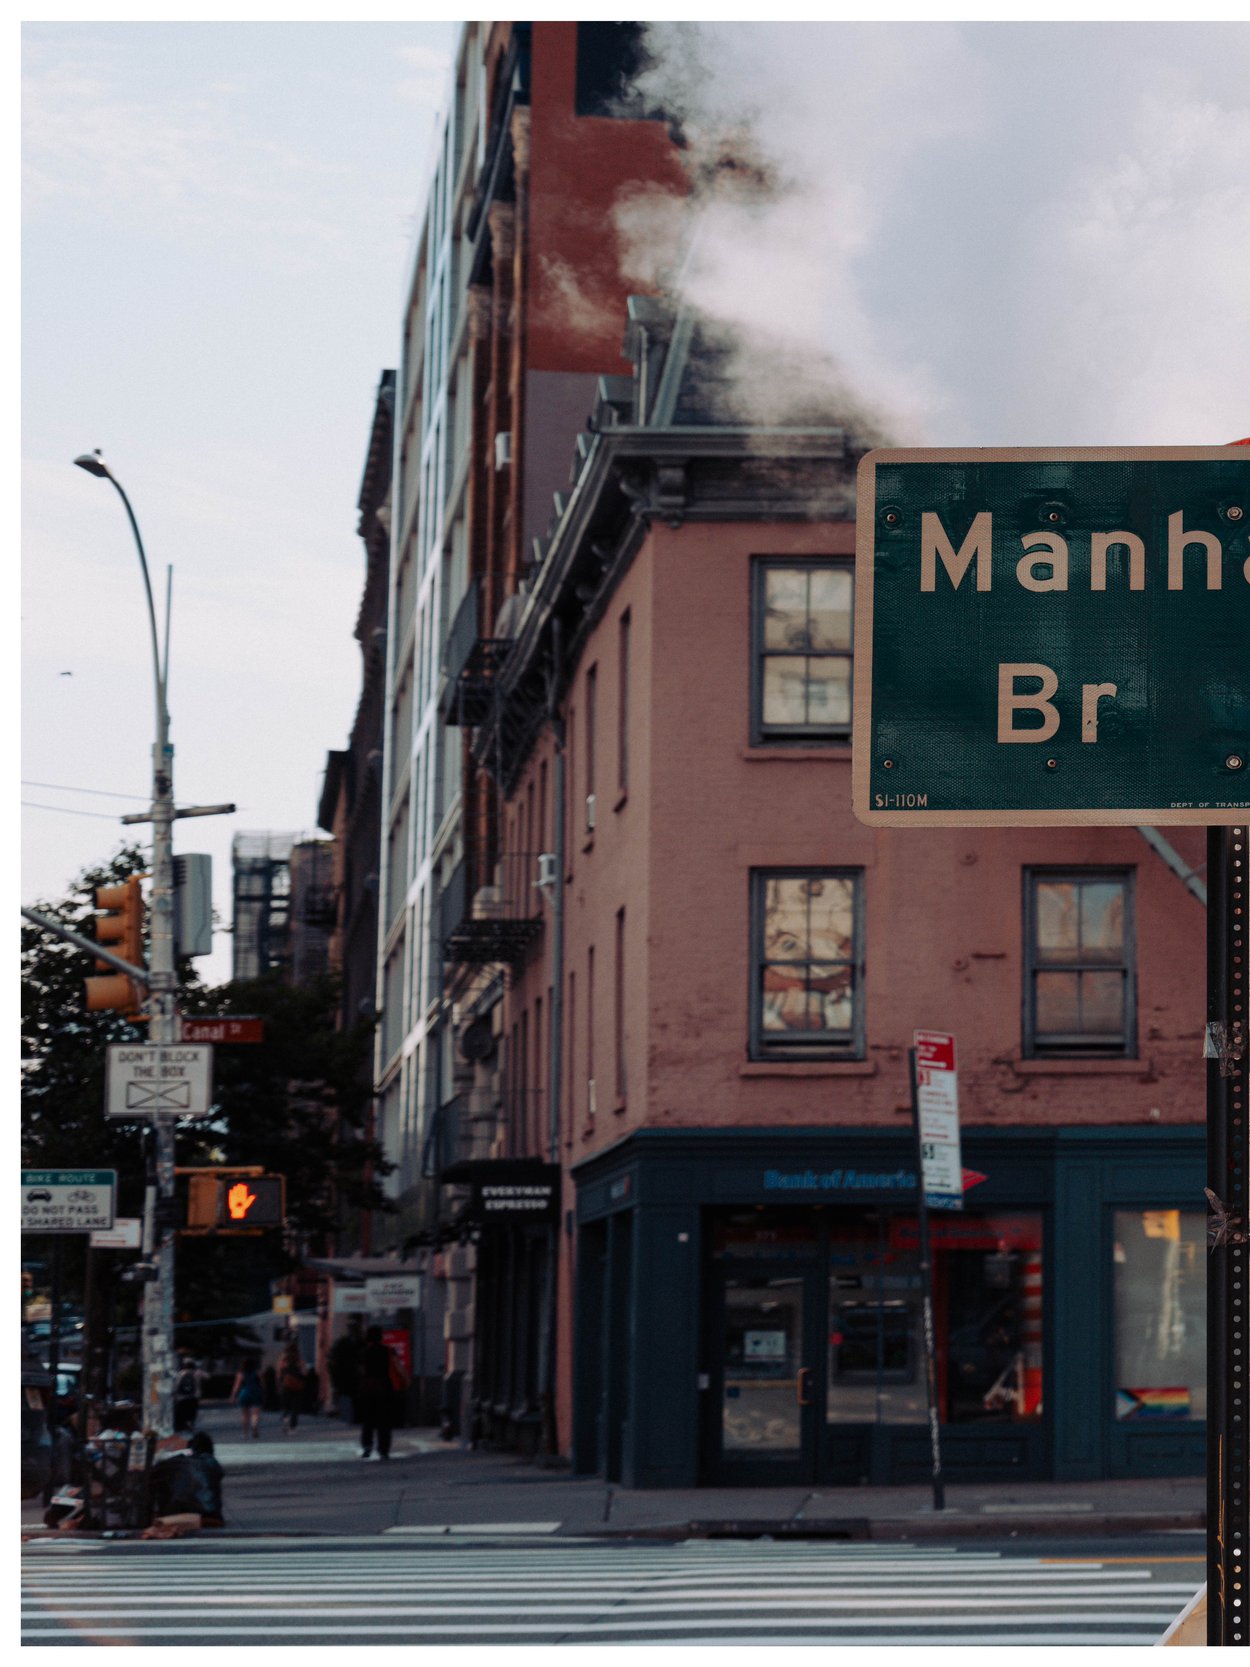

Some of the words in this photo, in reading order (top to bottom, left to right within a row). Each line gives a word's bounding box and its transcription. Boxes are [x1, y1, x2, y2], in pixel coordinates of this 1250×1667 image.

[997, 662, 1118, 744] Br
[183, 1022, 225, 1040] Canal
[118, 1051, 155, 1063] DON'T
[160, 1051, 199, 1062] BLOCK
[133, 1066, 154, 1077] THE
[161, 1066, 186, 1077] BOX
[26, 1174, 52, 1183] BIKE
[58, 1173, 97, 1183] ROUTE
[765, 1170, 817, 1189] Bank
[819, 1169, 842, 1189] of
[844, 1170, 917, 1188] Americ
[481, 1185, 553, 1197] EVERYMAN
[42, 1205, 65, 1214] NOT
[68, 1205, 98, 1214] PASS
[485, 1199, 549, 1210] ESPRESSO
[27, 1217, 73, 1226] SHARED
[77, 1216, 107, 1226] LANE
